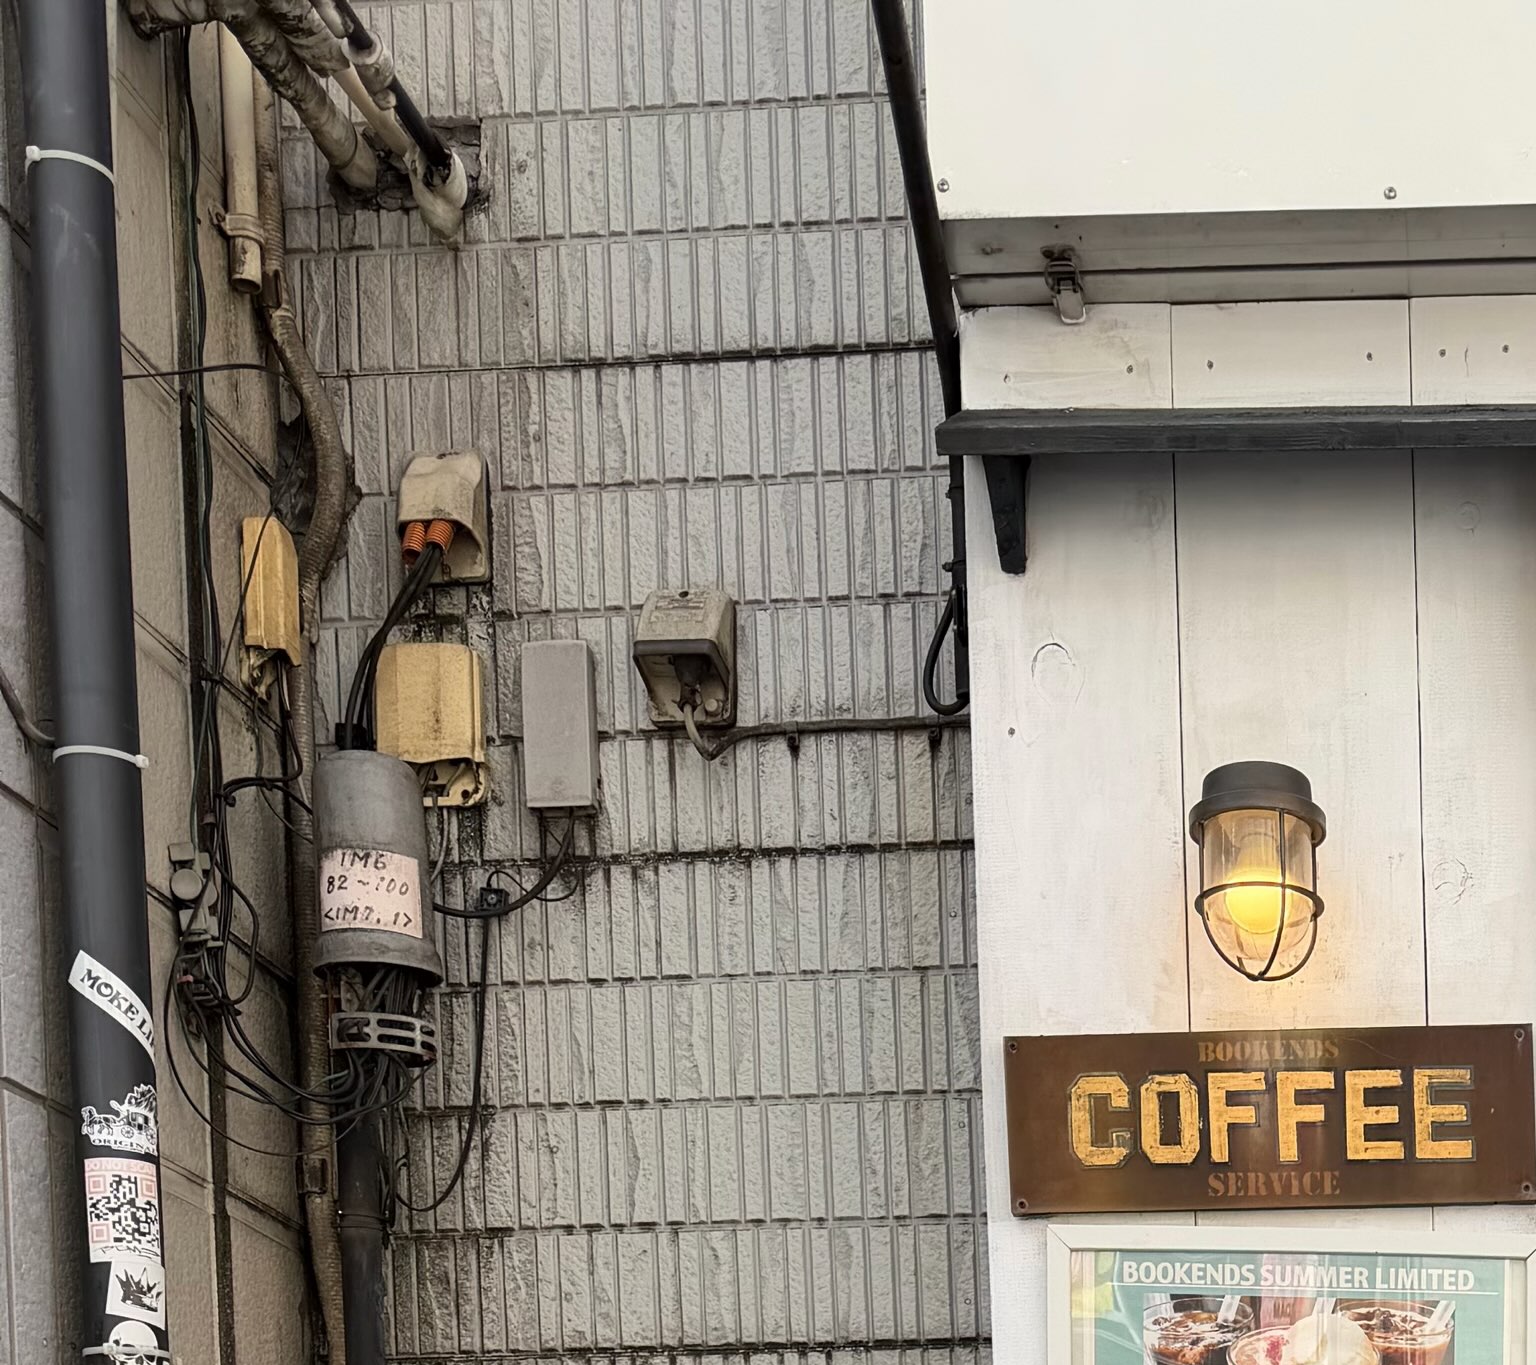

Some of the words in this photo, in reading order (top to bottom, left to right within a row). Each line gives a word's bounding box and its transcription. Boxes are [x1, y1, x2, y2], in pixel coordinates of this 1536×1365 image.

[79, 968, 139, 1021] MOKE
[1198, 1039, 1338, 1063] BOOKENDS
[1069, 1068, 1474, 1167] COFFEE
[1207, 1170, 1340, 1197] SERVICE
[1121, 1260, 1255, 1287] BOOKENDS
[1260, 1264, 1368, 1288] SUMMER
[1374, 1267, 1475, 1291] LIMITED
